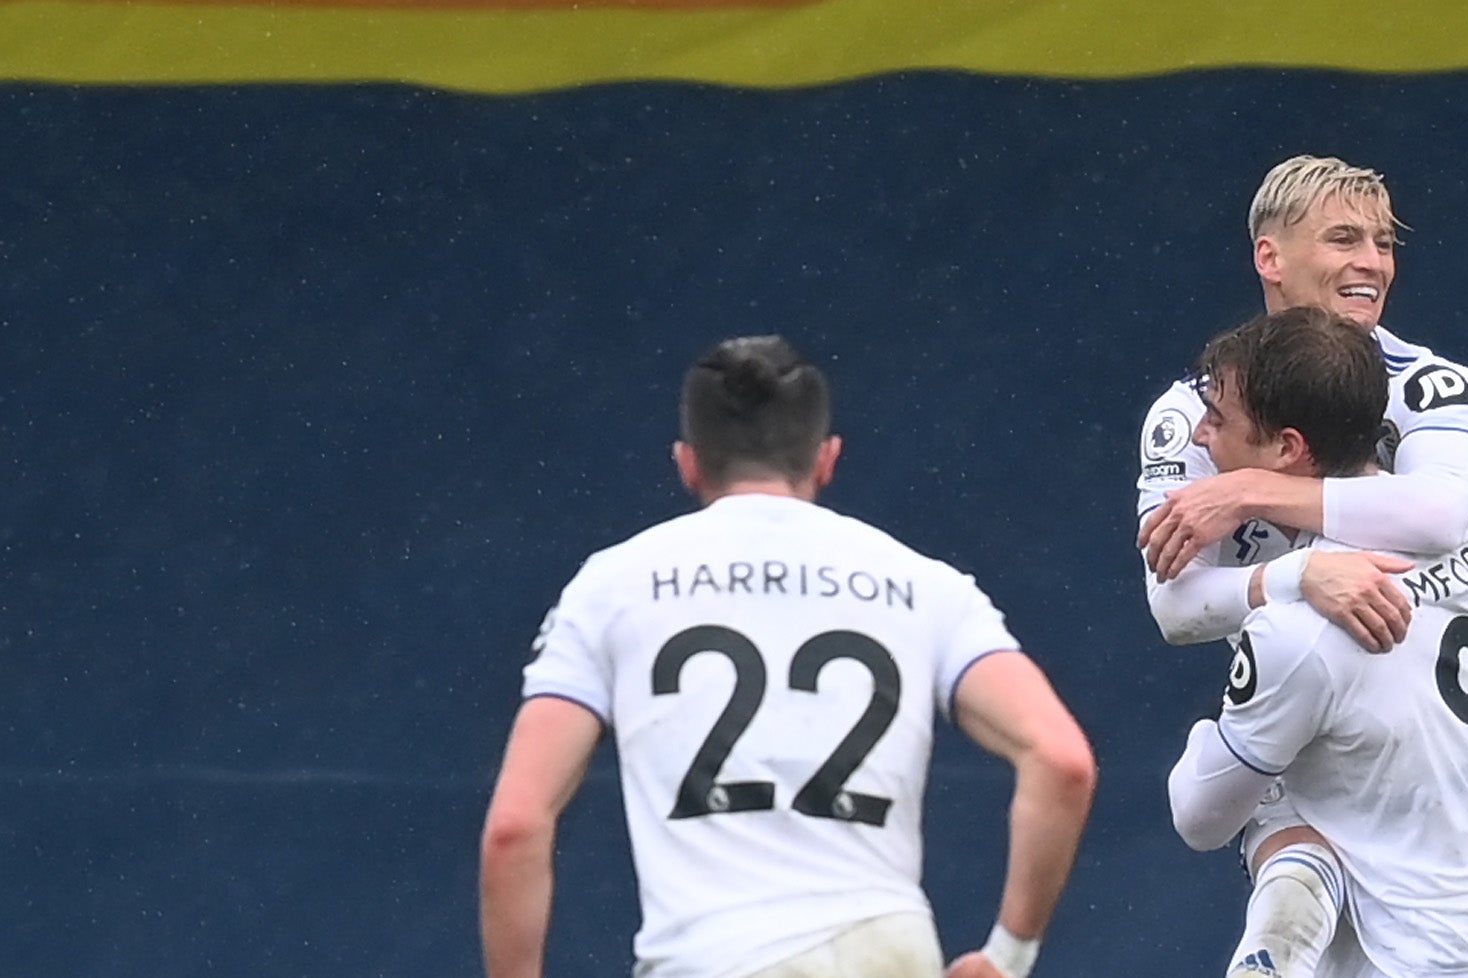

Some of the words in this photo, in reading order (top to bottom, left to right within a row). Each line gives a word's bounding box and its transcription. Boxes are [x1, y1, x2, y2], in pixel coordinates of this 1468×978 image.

[1418, 369, 1466, 410] JD
[652, 560, 914, 611] HARRISON
[651, 624, 902, 828] 22
